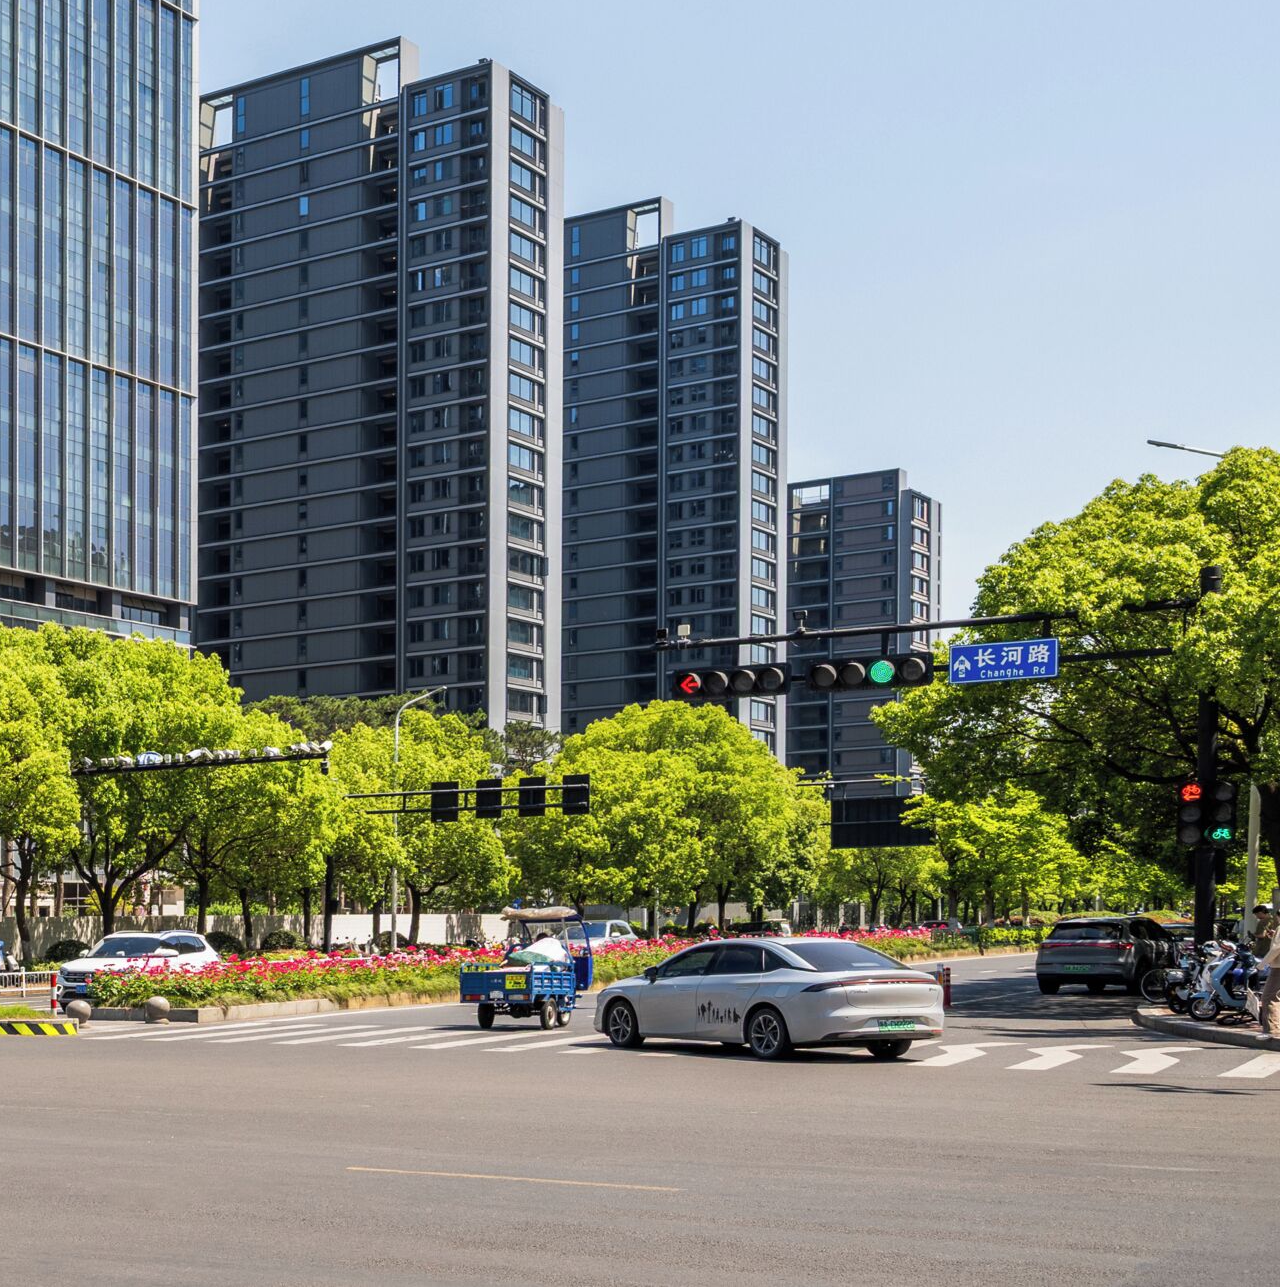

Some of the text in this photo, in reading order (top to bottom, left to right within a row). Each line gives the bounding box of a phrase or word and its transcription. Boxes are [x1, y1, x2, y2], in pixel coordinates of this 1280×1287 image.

[973, 644, 1051, 668] 长河路
[980, 666, 1046, 679] Changhe Rd
